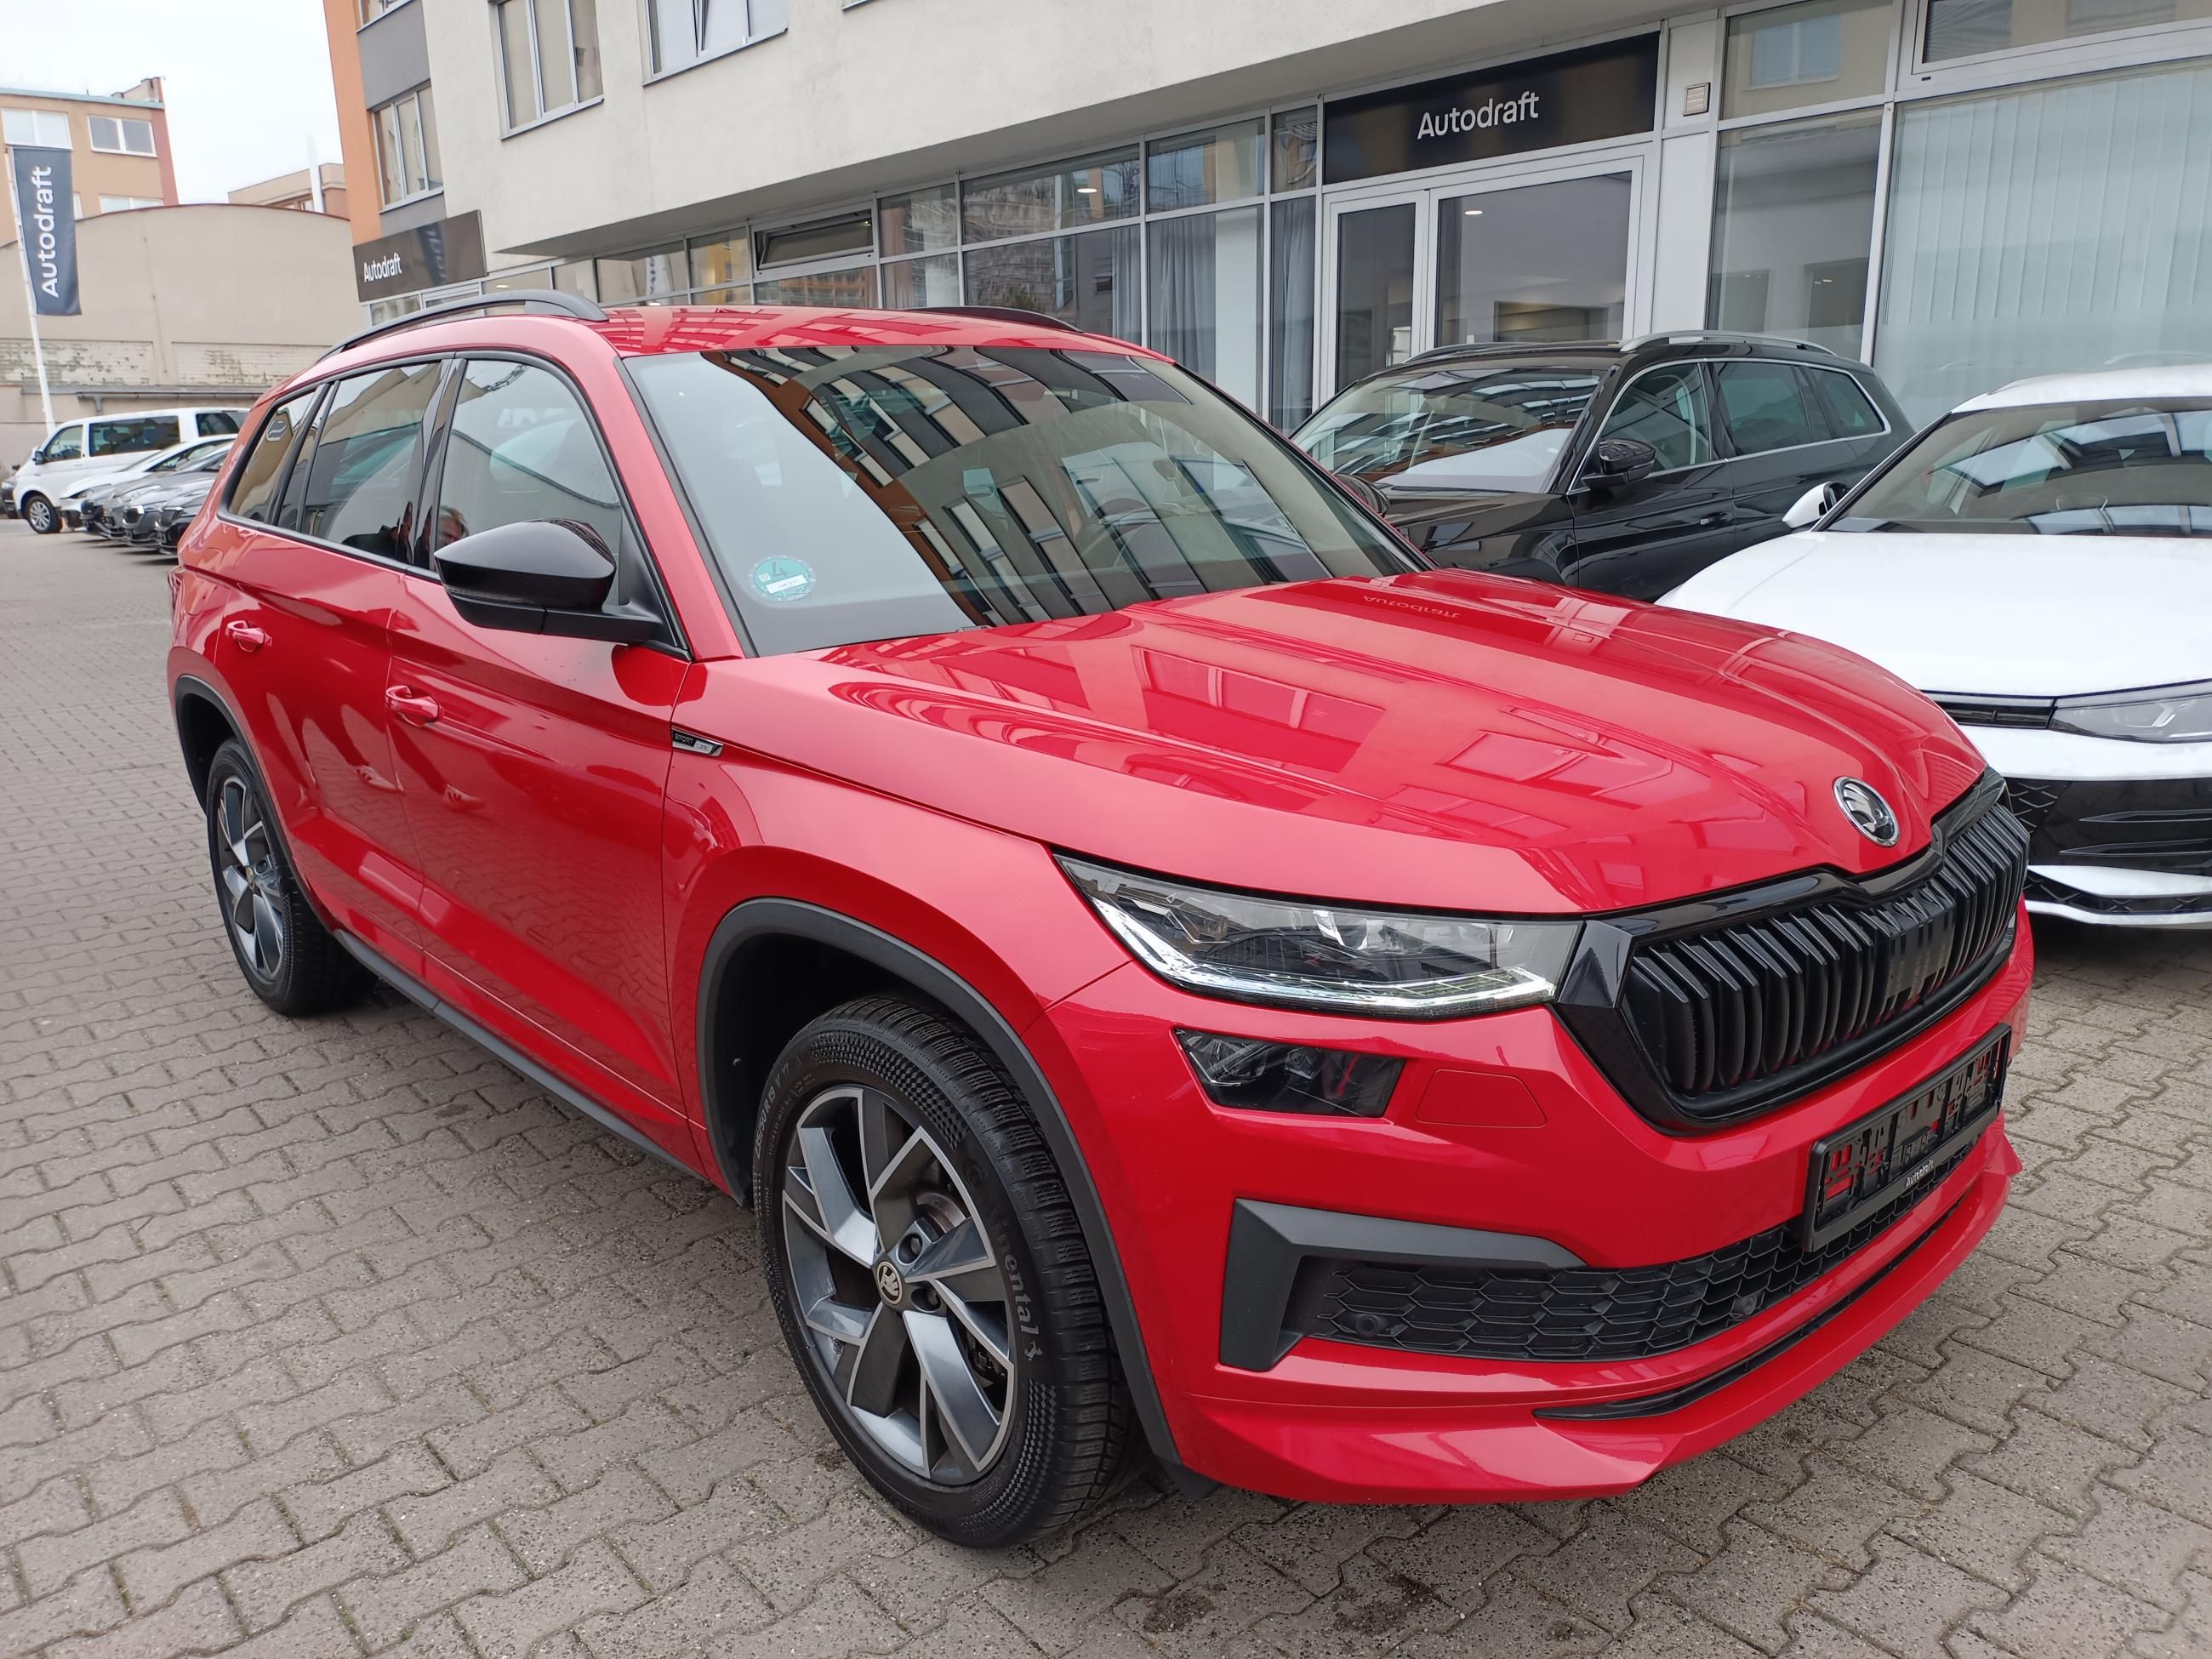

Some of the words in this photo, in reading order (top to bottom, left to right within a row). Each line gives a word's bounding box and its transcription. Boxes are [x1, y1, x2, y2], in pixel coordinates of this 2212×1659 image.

[1417, 90, 1540, 140] Autodraft
[31, 165, 60, 299] Autodraft
[363, 252, 402, 283] Autodraft
[962, 1158, 1040, 1335] Cinental
